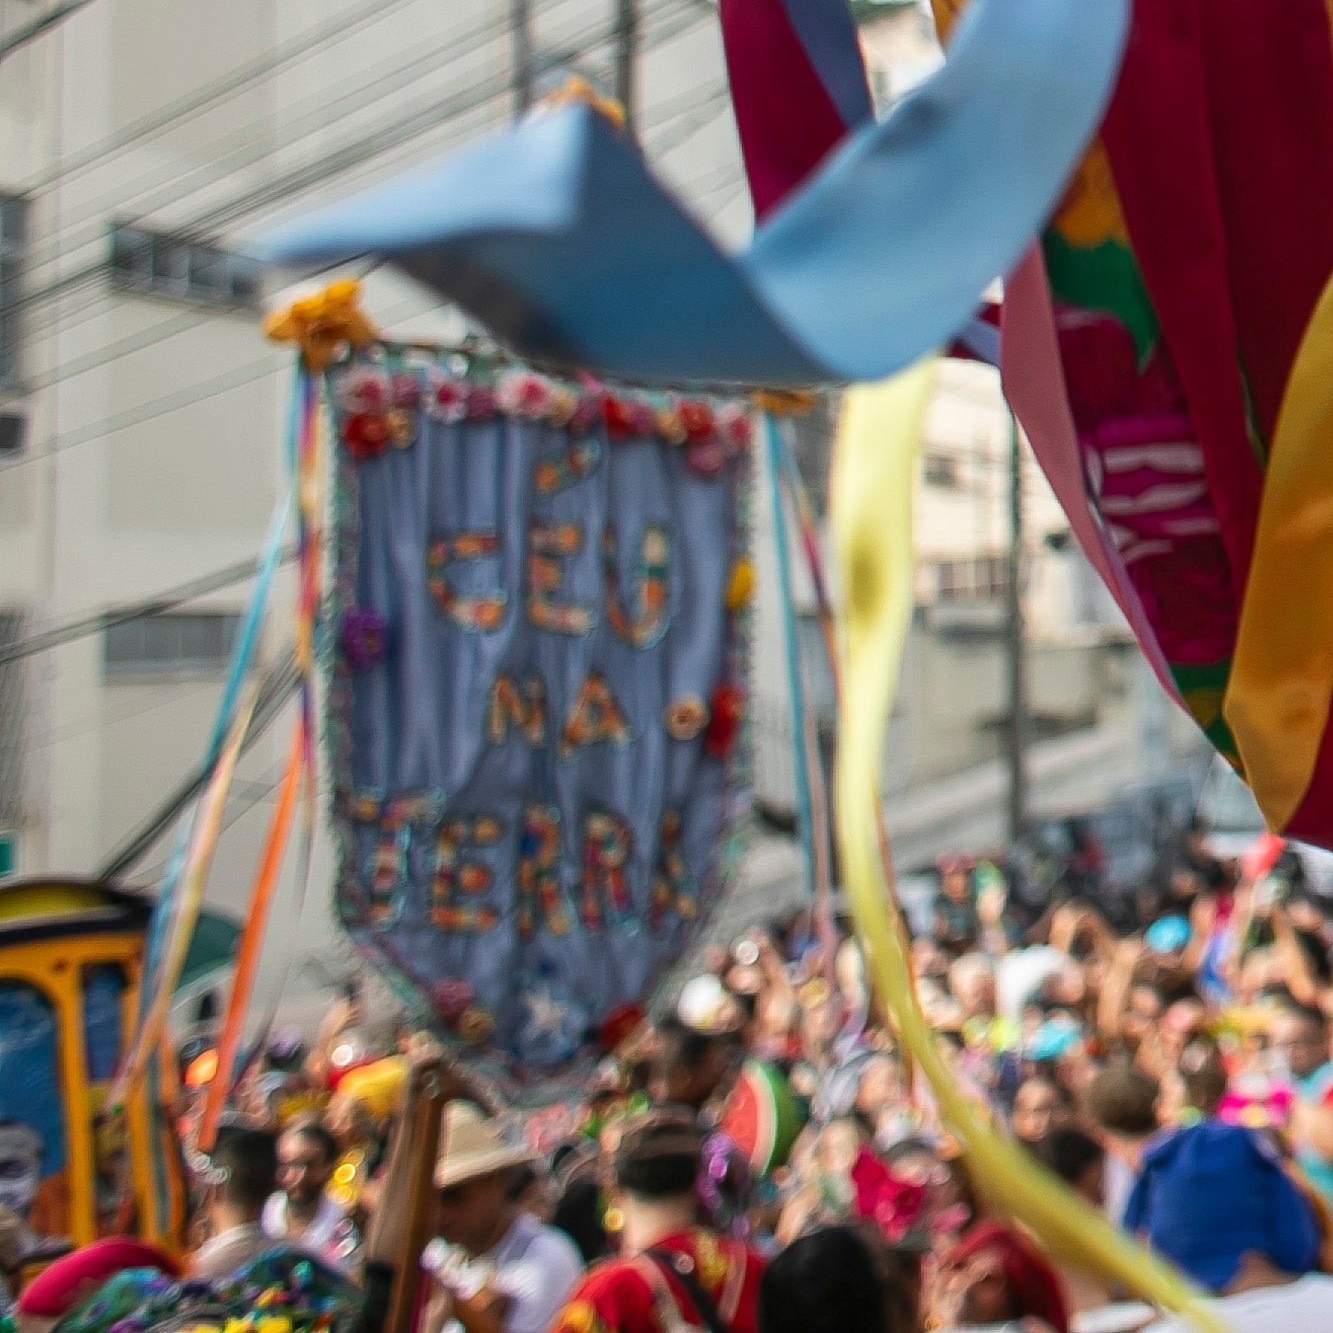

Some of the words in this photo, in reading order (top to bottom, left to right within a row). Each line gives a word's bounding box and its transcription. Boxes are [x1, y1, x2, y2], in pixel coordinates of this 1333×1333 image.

[427, 437, 674, 641] CÉU
[487, 669, 636, 759] NA
[350, 786, 698, 933] TERRA
